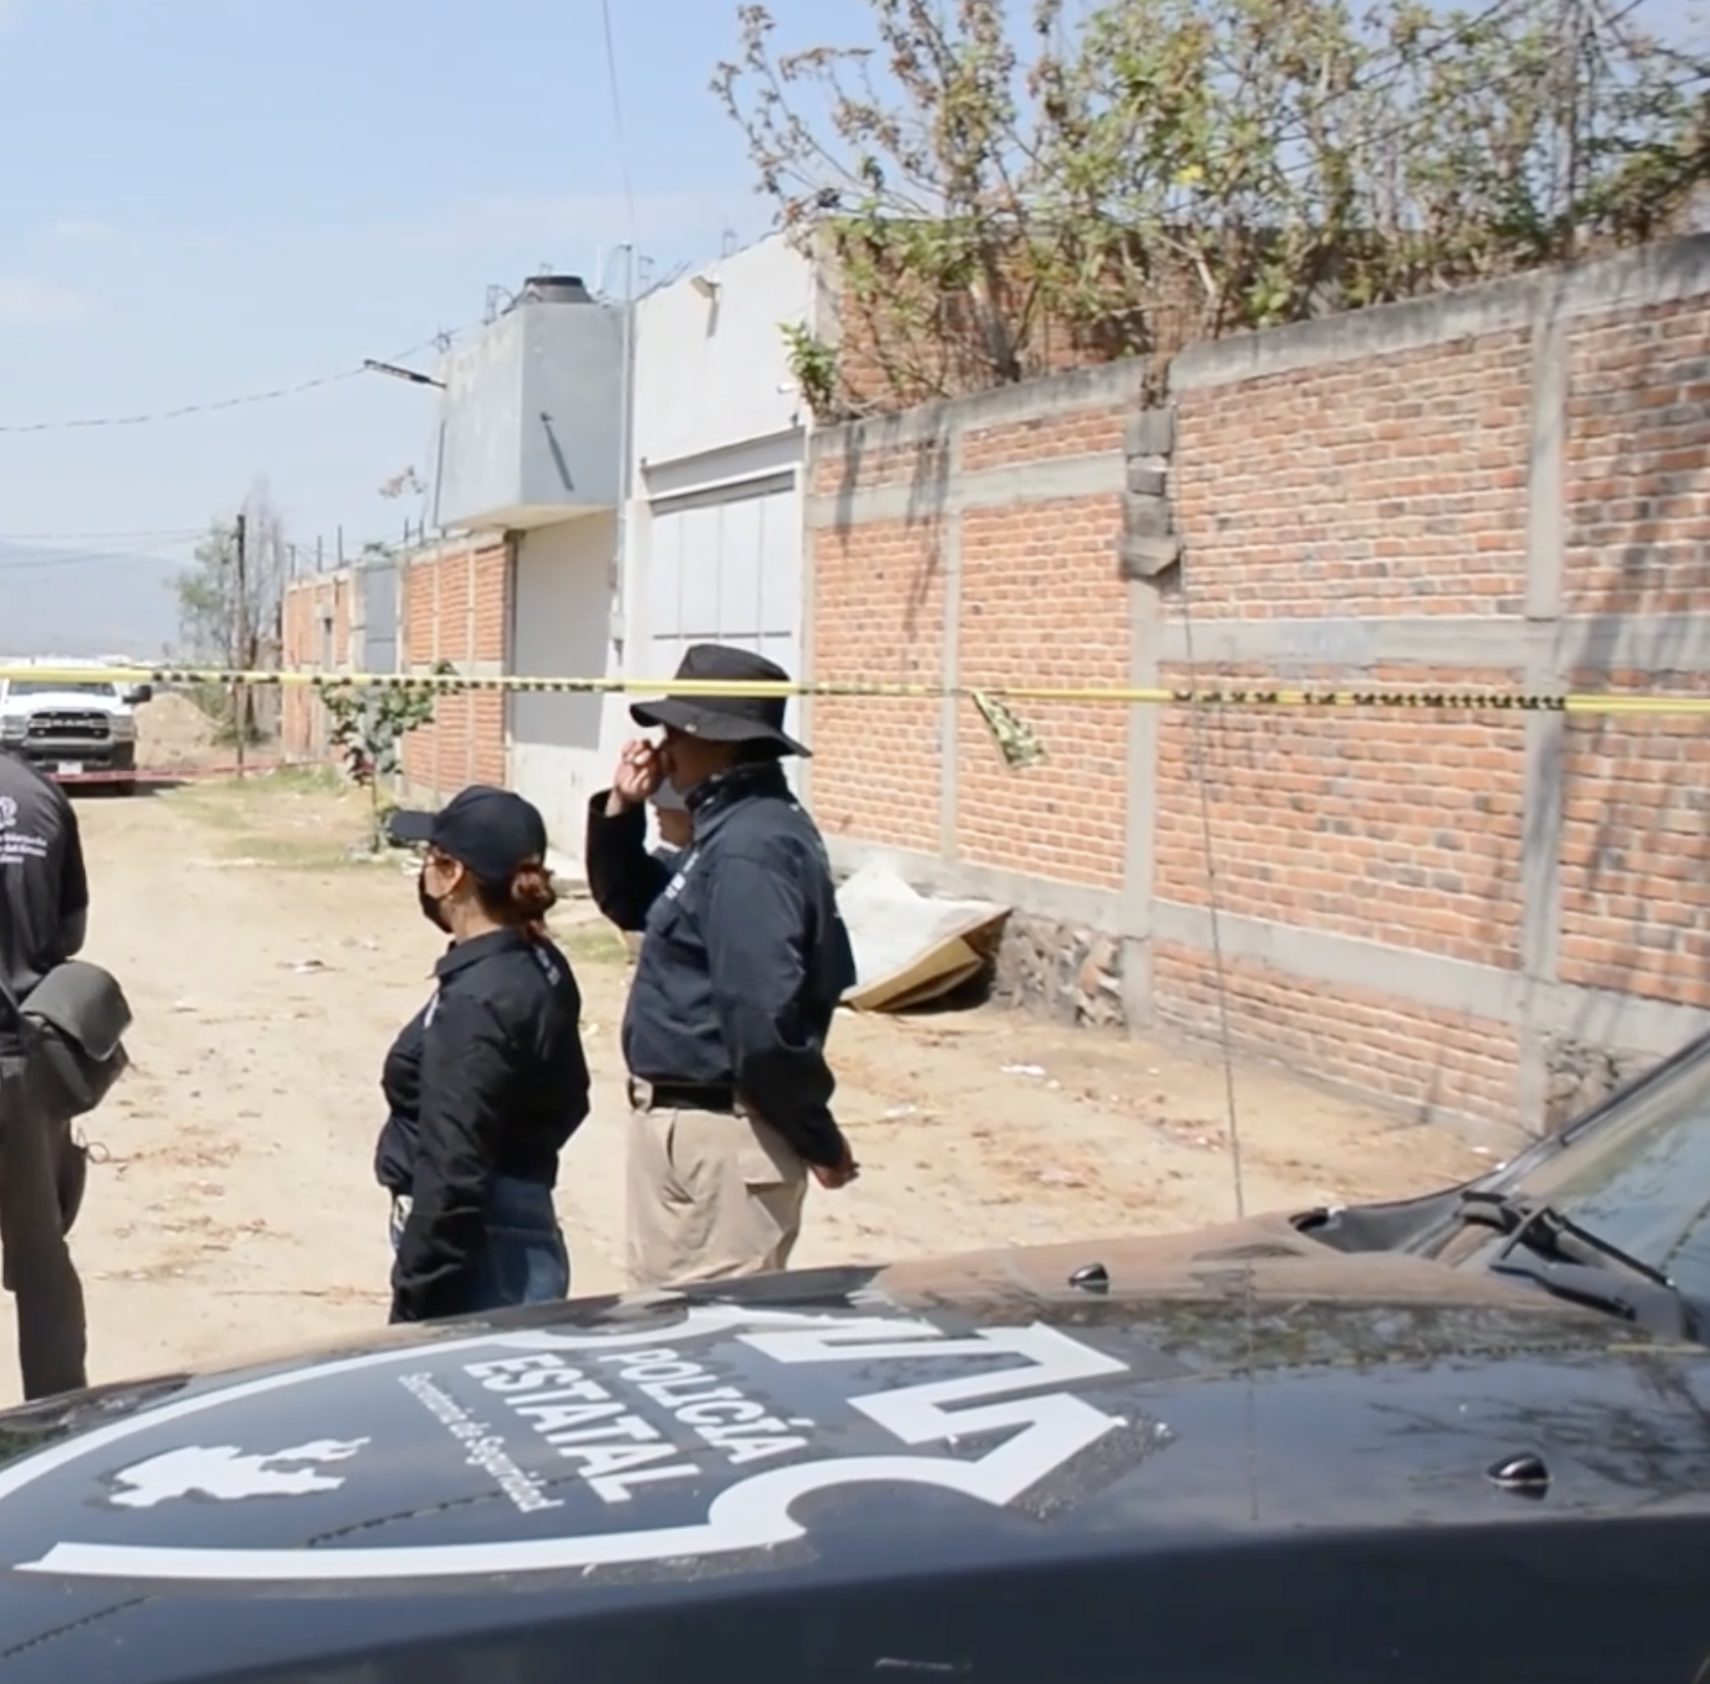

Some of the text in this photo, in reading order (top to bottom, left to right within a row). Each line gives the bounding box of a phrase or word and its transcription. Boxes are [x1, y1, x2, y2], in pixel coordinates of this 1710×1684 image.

[52, 718, 87, 727] RAM
[462, 1352, 701, 1502] ESTATAL
[597, 1347, 815, 1464] POLICÍA
[464, 1435, 566, 1513] Seguridad
